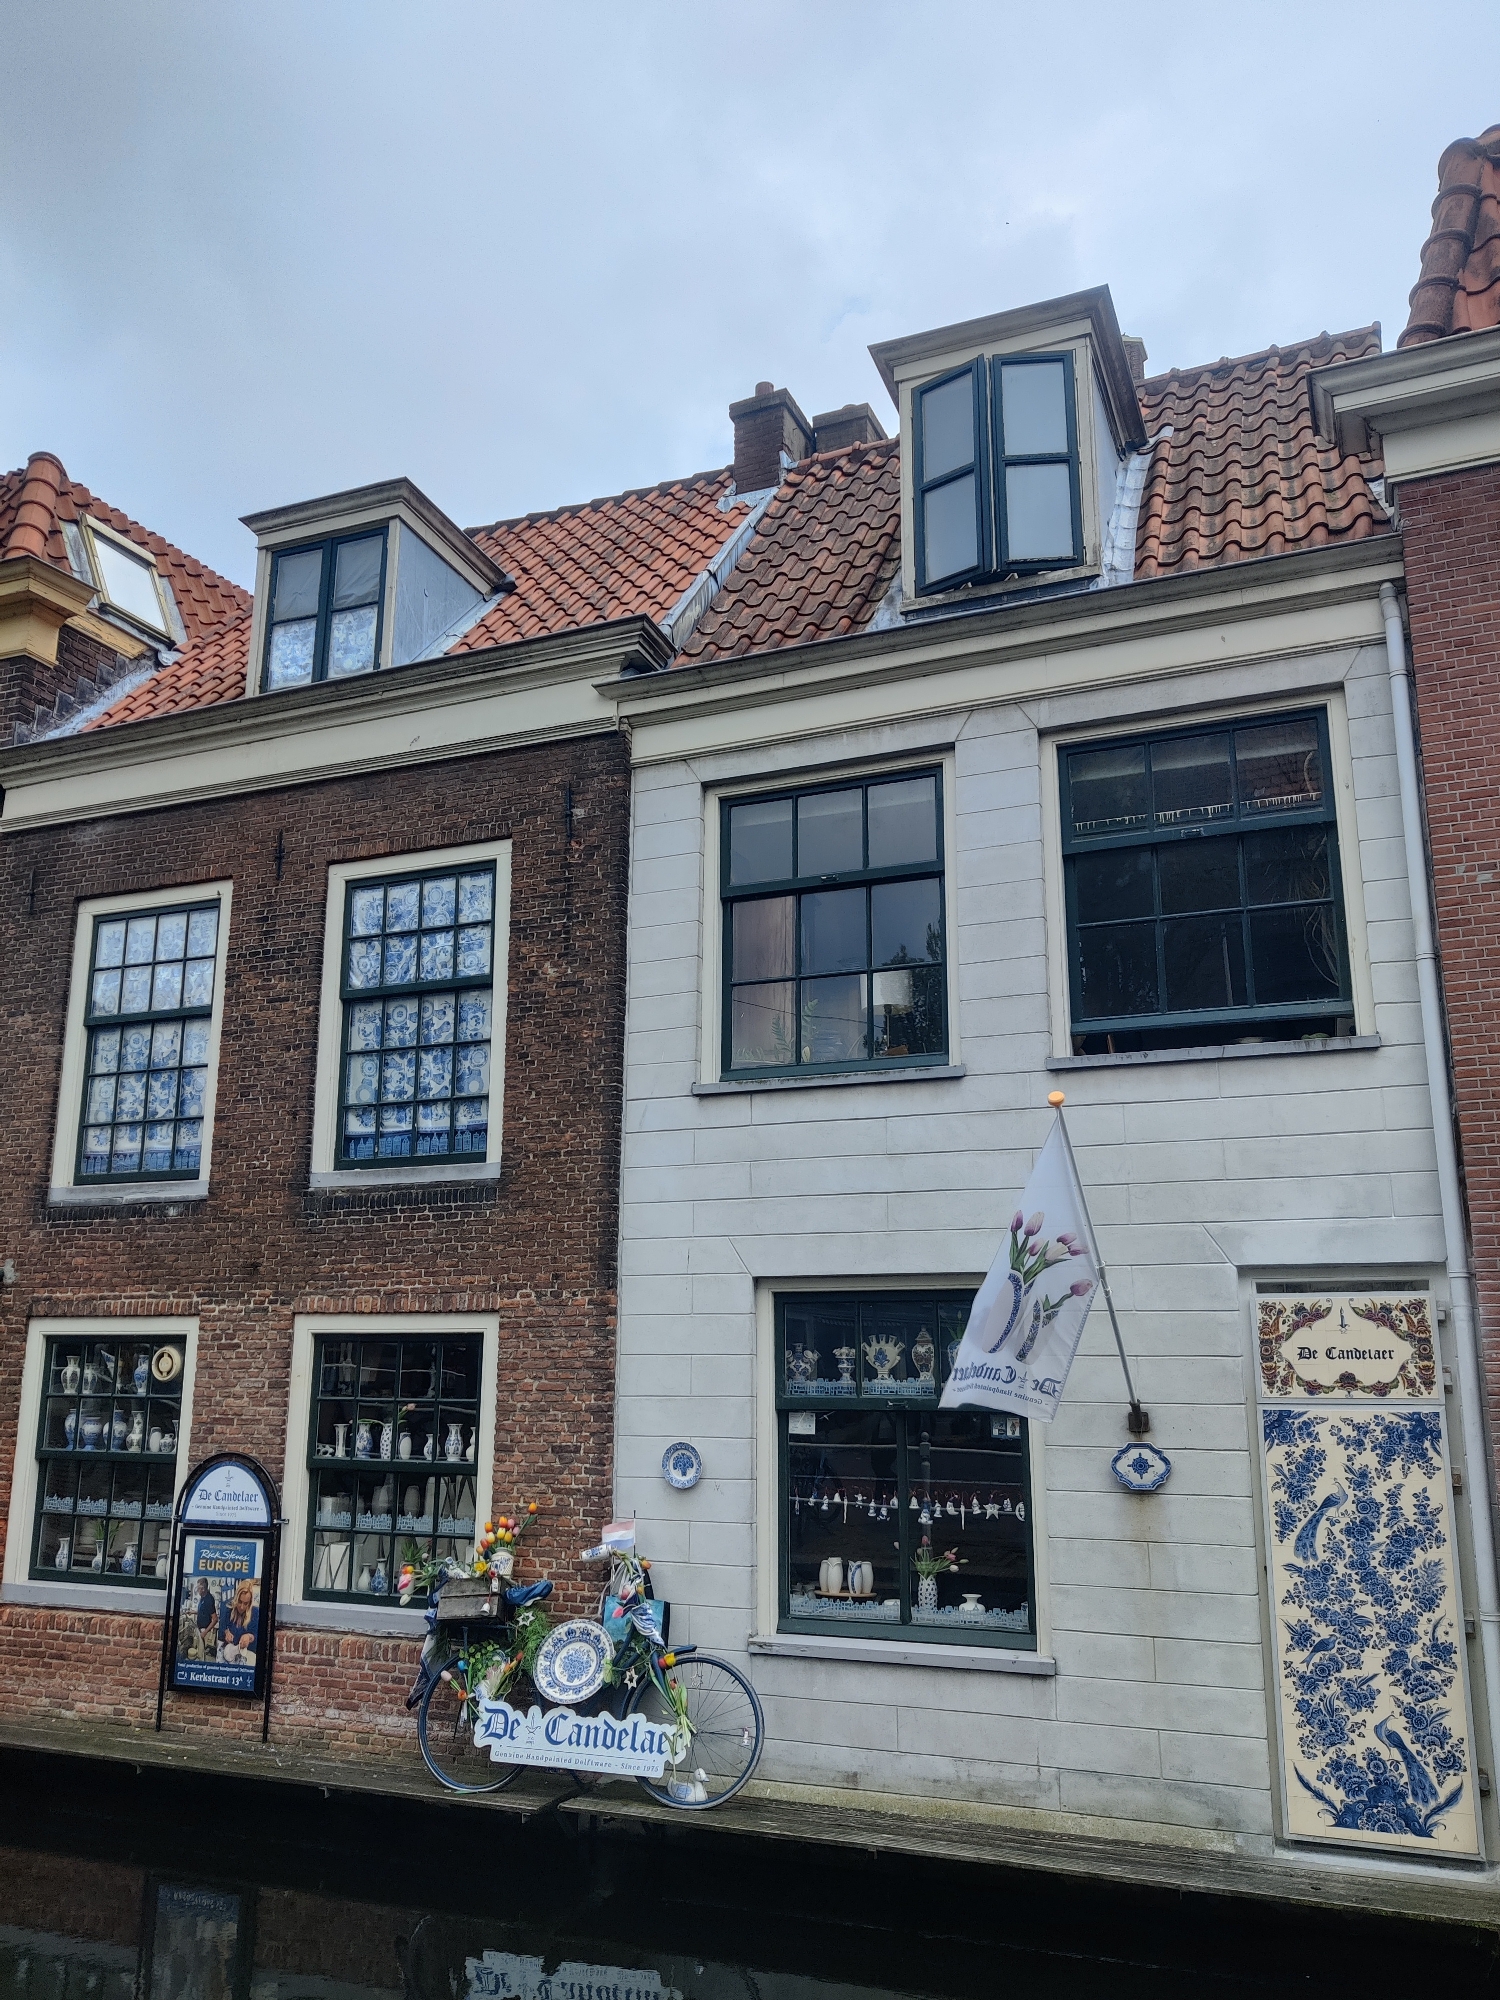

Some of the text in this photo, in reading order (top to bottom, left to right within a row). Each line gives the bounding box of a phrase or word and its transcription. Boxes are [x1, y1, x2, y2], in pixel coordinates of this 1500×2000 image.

[1297, 1346, 1395, 1360] De Candelaer
[199, 1488, 259, 1502] De Candelaer
[200, 1549, 221, 1559] Rick
[199, 1559, 250, 1573] EUROPE
[190, 1671, 229, 1684] Kerkstraat
[480, 1706, 521, 1741] De
[494, 1750, 524, 1759] Genuine
[525, 1753, 572, 1764] Handpainted
[620, 1763, 641, 1772] Since
[642, 1765, 660, 1773] 1975
